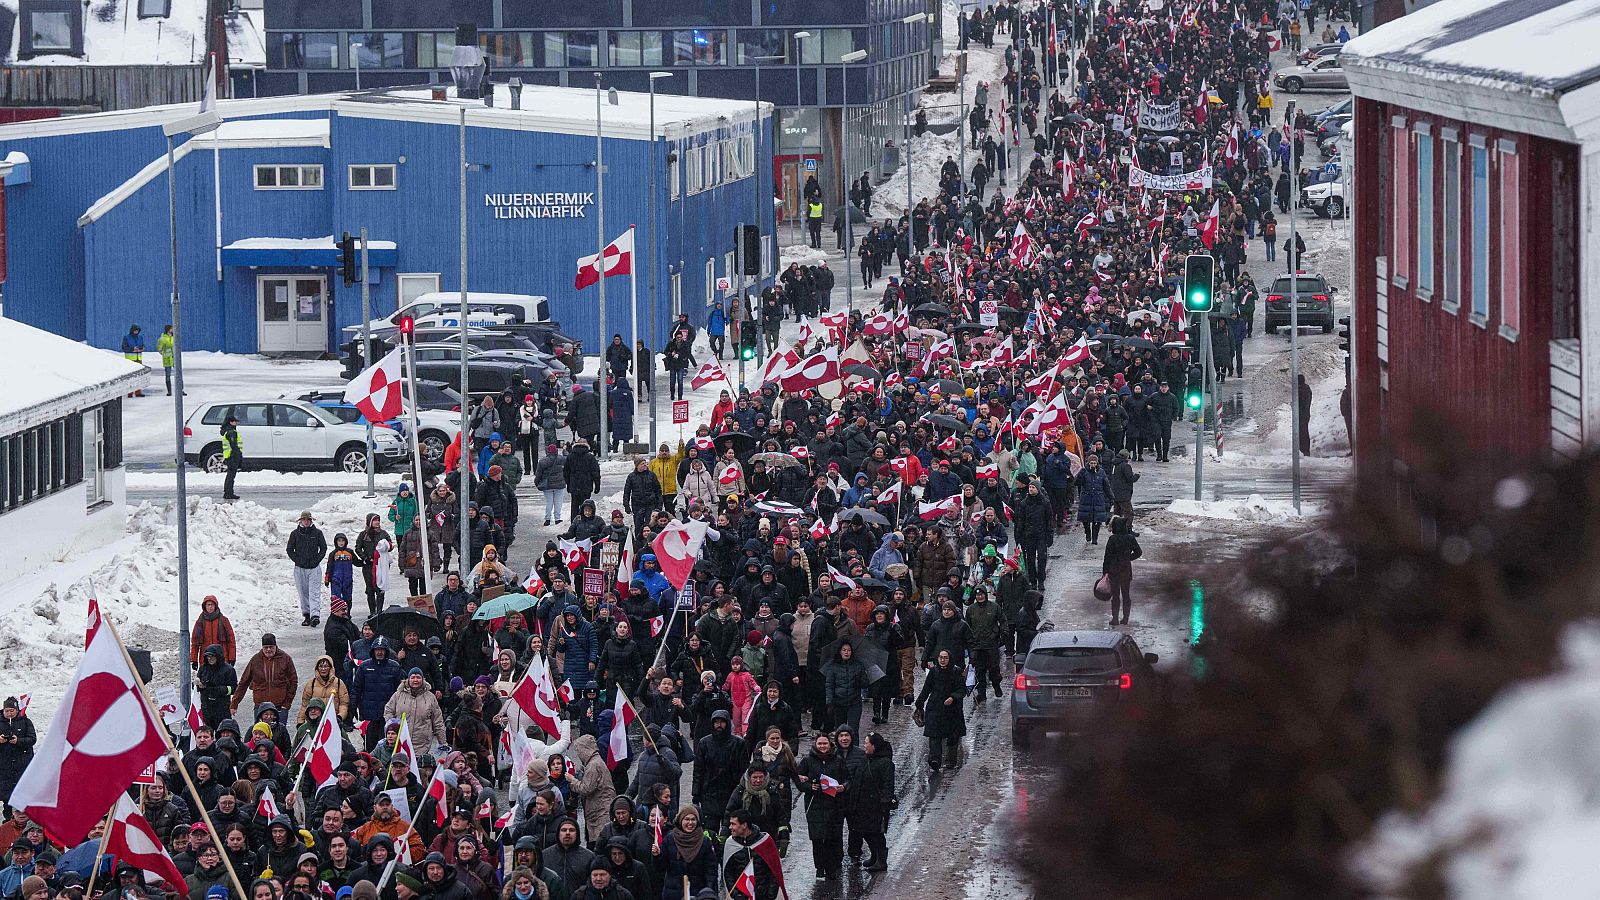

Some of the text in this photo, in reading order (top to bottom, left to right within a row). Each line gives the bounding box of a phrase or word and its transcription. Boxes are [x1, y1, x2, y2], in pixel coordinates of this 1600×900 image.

[1141, 113, 1157, 127] GO
[785, 127, 808, 135] SPAR
[485, 192, 594, 206] NIUERNERMIK
[494, 205, 585, 219] ILINNIARFIK
